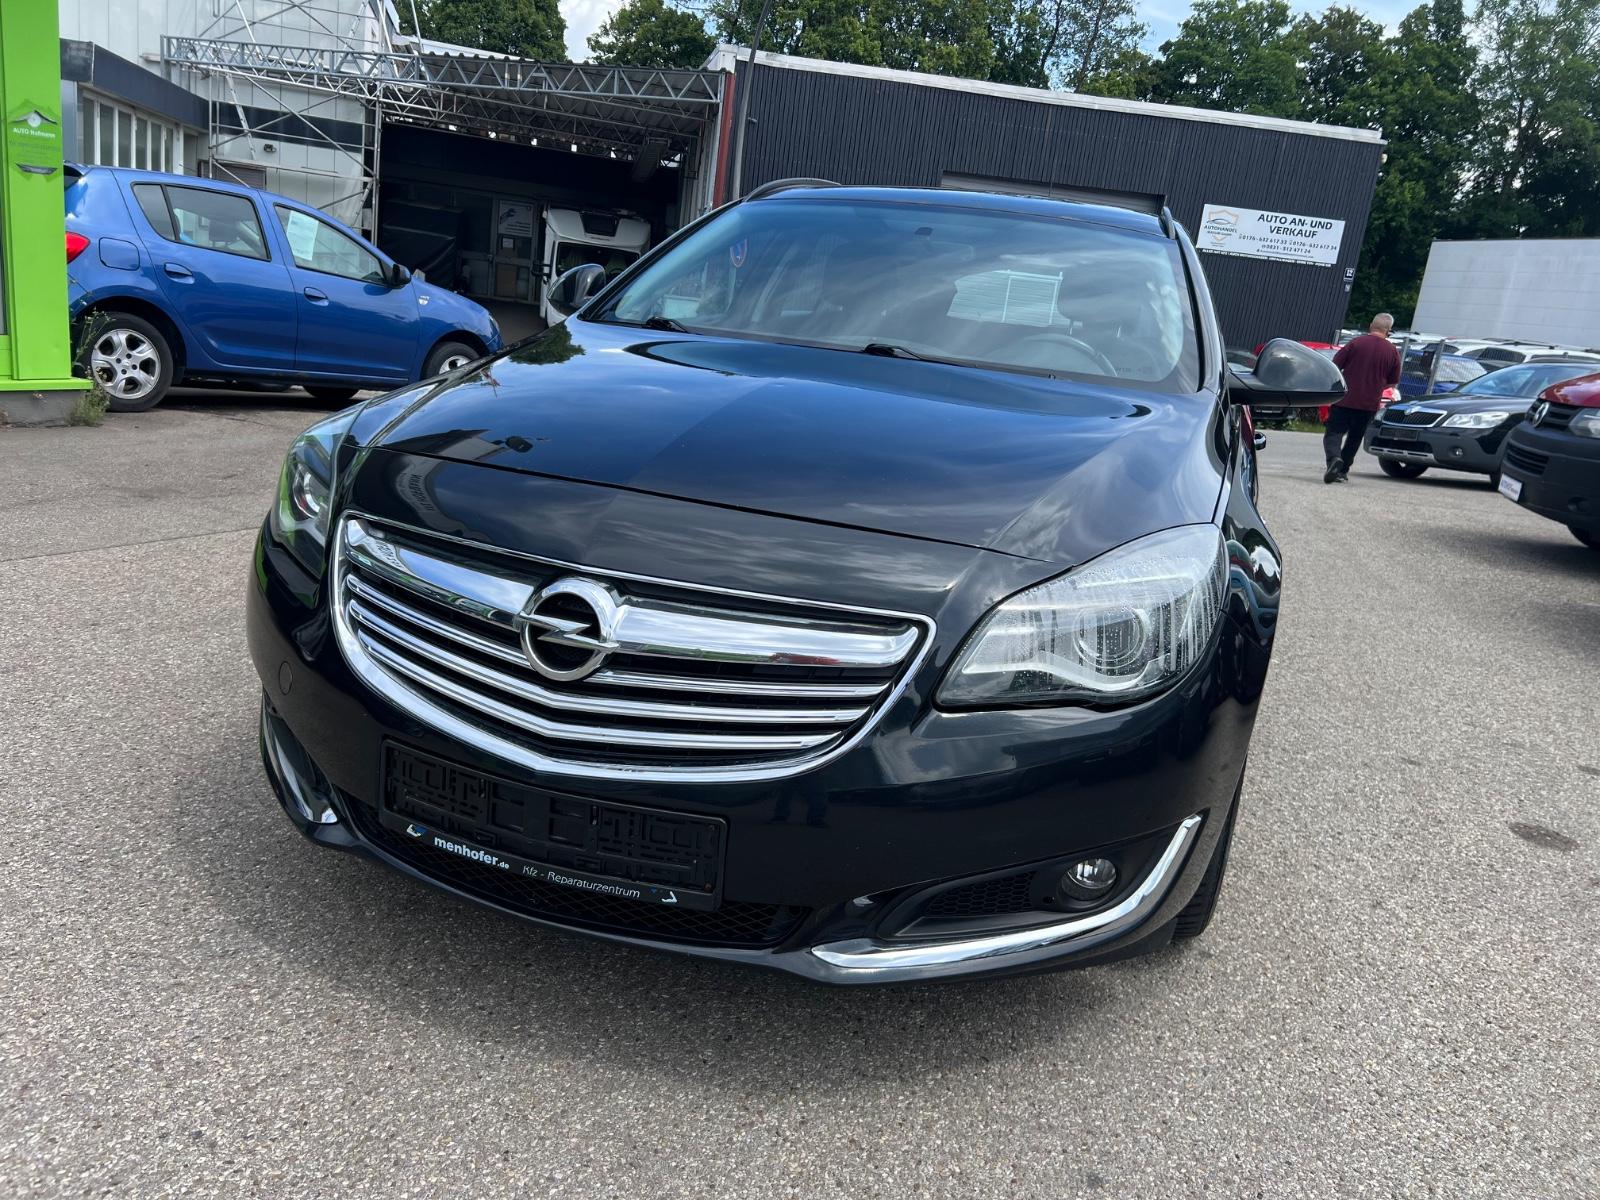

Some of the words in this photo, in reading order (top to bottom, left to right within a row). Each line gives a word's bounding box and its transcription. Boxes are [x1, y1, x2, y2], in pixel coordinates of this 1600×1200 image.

[1257, 213, 1287, 225] AUTO
[1310, 220, 1333, 230] UND
[1269, 225, 1318, 239] VERKAUF
[434, 835, 510, 870] menhofer.de
[522, 865, 538, 877] Kfz
[547, 871, 641, 899] Reparaturzentrum
